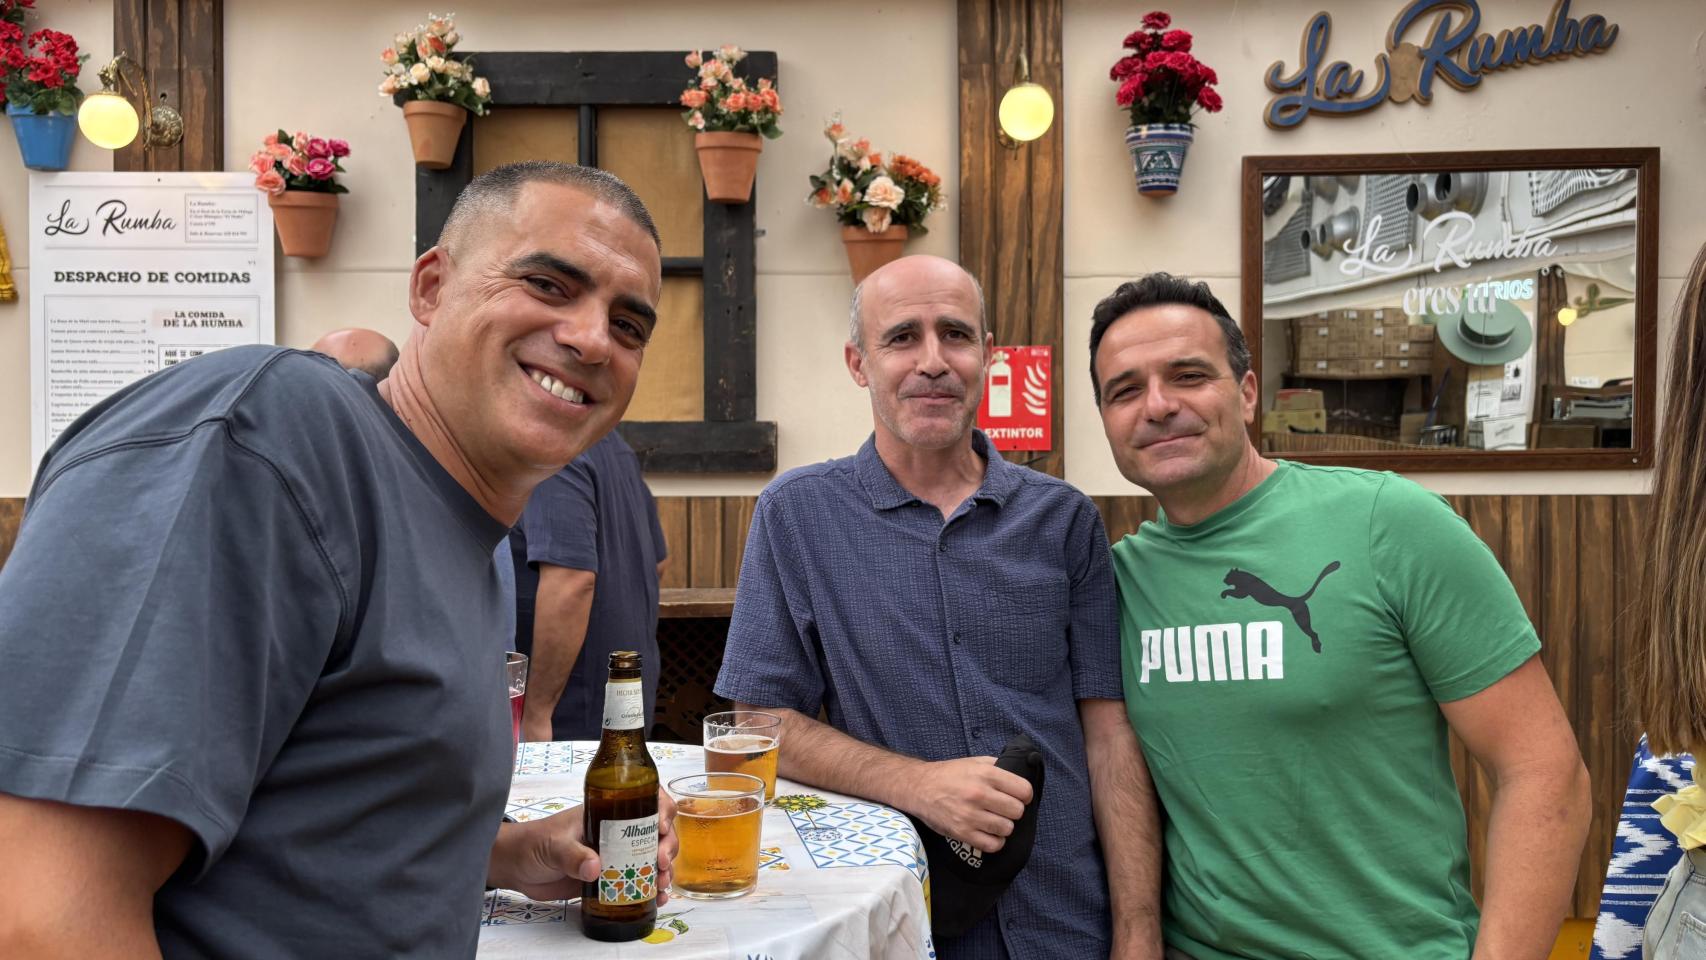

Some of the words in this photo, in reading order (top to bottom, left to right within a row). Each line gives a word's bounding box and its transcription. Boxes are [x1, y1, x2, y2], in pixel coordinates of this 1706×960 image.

[1264, 11, 1391, 130] La
[1386, 0, 1620, 105] Rumba
[45, 199, 90, 236] La
[95, 199, 177, 237] Rumba
[1339, 214, 1413, 276] La
[1423, 210, 1559, 273] Rumba
[53, 271, 142, 284] DESPACHO
[147, 271, 169, 284] DE
[174, 271, 251, 284] COMIDAS
[174, 311, 185, 319] LA
[187, 311, 225, 319] COMIDA
[1403, 286, 1461, 316] eres
[162, 319, 180, 328] DE
[182, 319, 198, 328] LA
[201, 319, 244, 328] RUMBA
[984, 427, 1044, 439] EXTINTOR
[1139, 620, 1284, 684] PUMA
